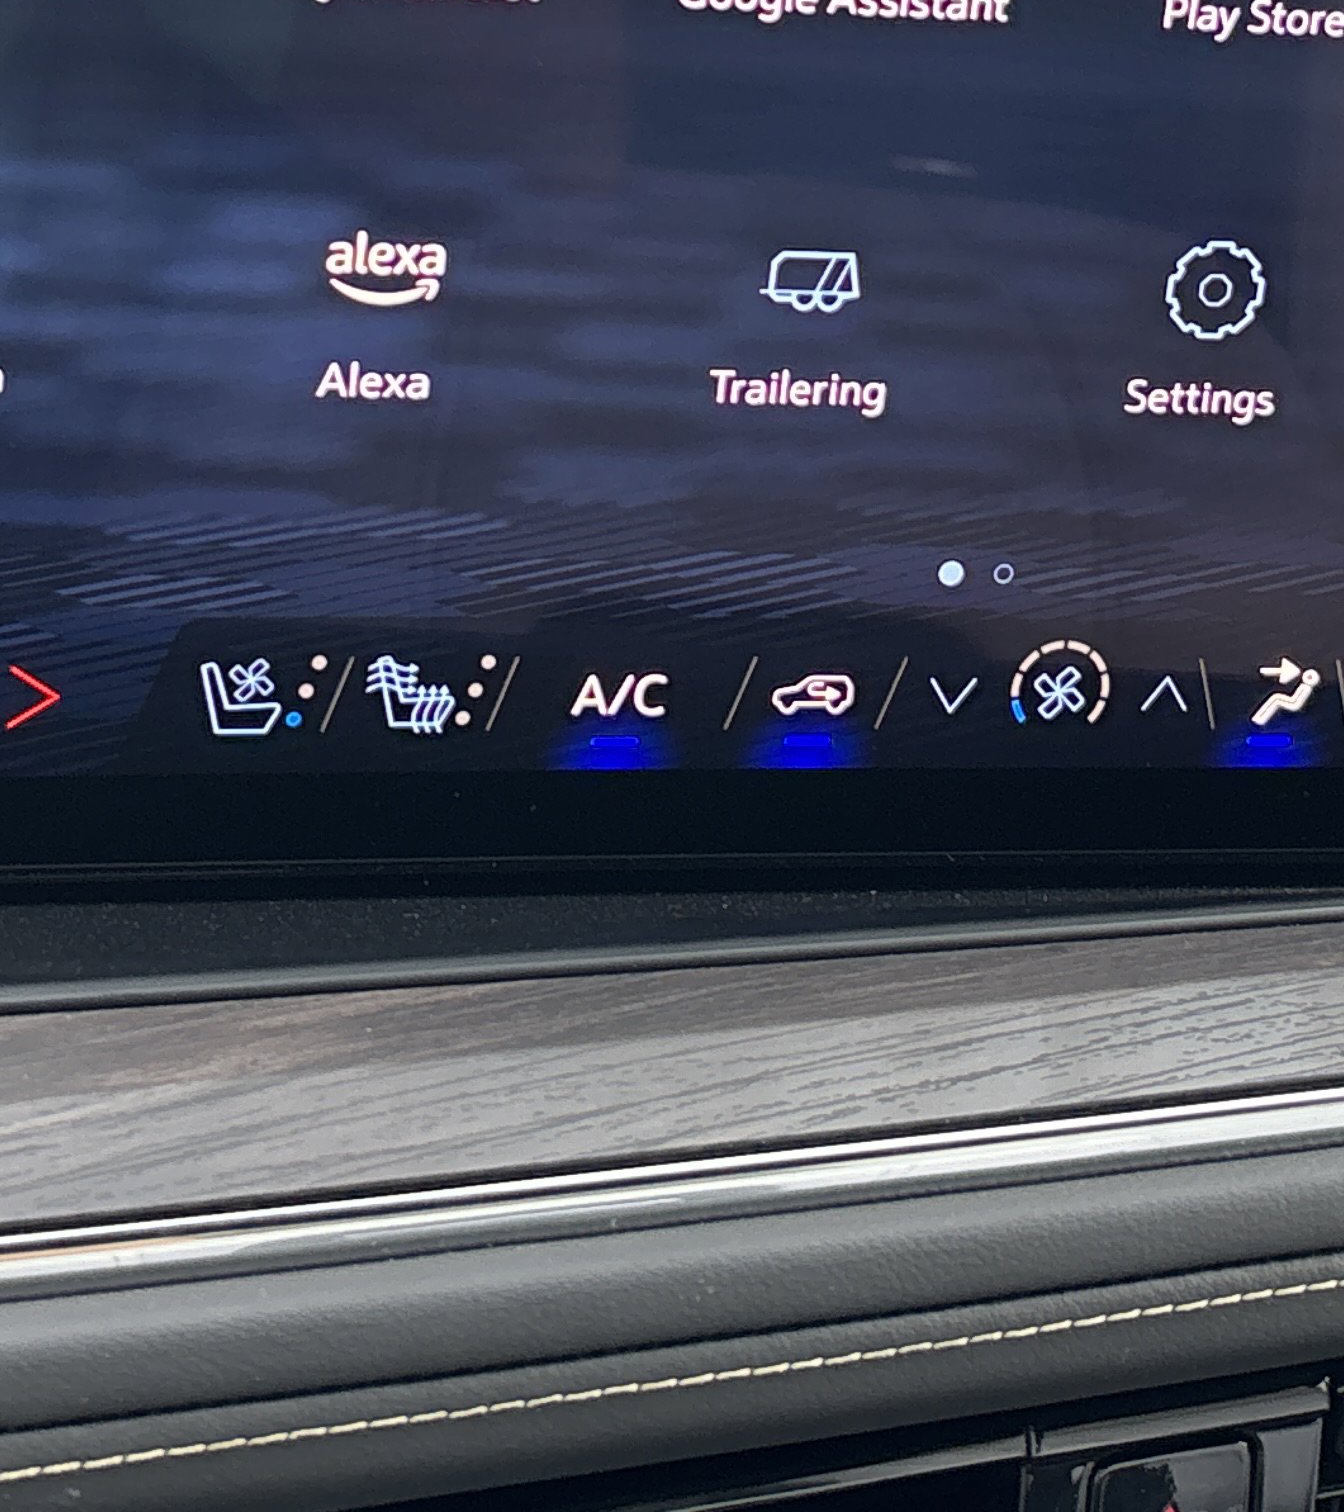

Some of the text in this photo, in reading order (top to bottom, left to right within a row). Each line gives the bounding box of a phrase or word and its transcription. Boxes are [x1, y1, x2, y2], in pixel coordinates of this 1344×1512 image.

[324, 229, 448, 277] alexa
[314, 359, 432, 401] Alexa
[708, 367, 888, 419] Trailering
[1122, 377, 1276, 425] Settings
[569, 672, 669, 719] A/C
